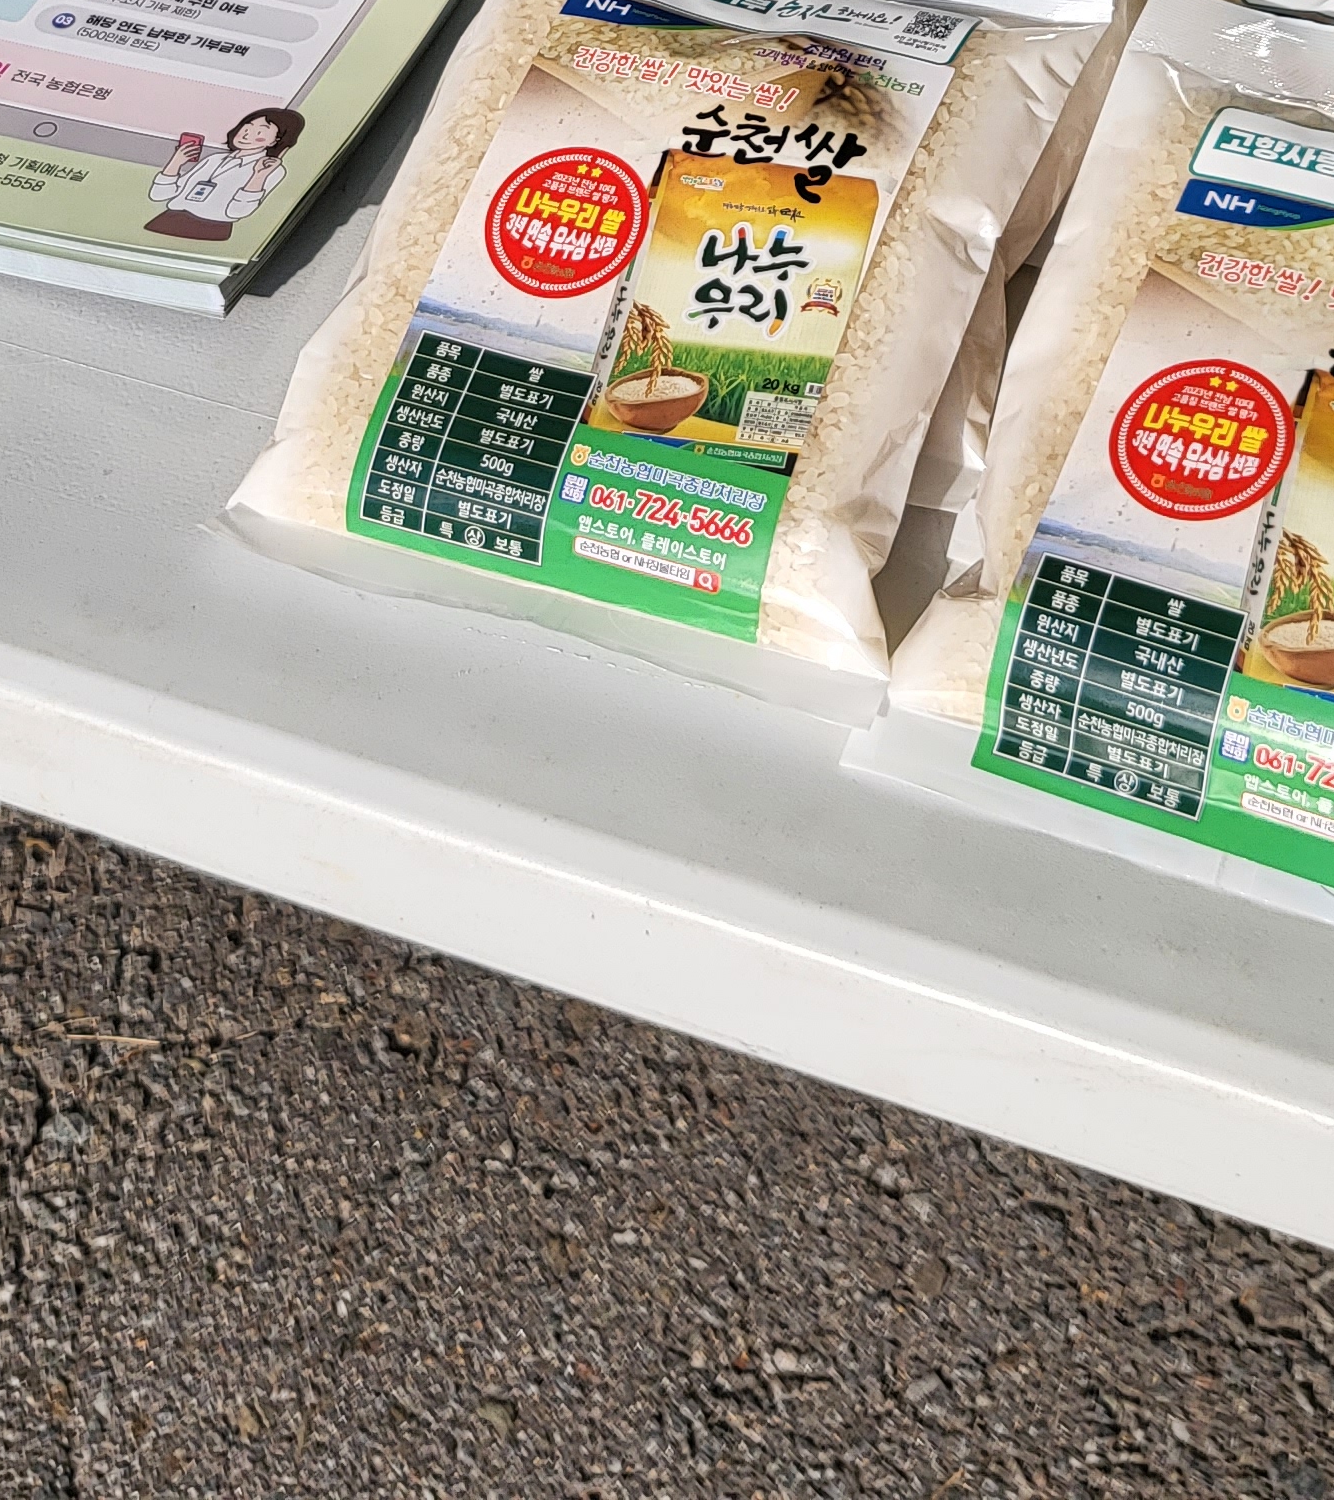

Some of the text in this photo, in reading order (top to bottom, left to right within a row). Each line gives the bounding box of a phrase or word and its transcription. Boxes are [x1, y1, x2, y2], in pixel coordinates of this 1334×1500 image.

[145, 0, 171, 13] 기부
[218, 1, 249, 15] 여부
[56, 14, 252, 57] 03 해당 연도 납부한 기부금액
[131, 38, 161, 53] 한도)
[11, 69, 47, 87] 전국
[45, 77, 113, 101] 농협은행
[573, 46, 641, 76] 건강한
[686, 64, 751, 102] 맛있는
[9, 155, 90, 183] 기획예산실
[680, 104, 868, 203] 순천쌀
[516, 187, 627, 236] 나누우리 쌀
[1203, 189, 1256, 215] NH
[505, 212, 618, 261] 3년 연속 우수상 선정
[699, 227, 813, 282] 나누
[1198, 251, 1274, 290] 건강한
[688, 278, 790, 336] 우리
[425, 362, 556, 410] 품종 별도표기
[435, 340, 545, 384] 품목 쌀
[395, 403, 536, 454] 생산년도 별도표기
[409, 384, 537, 431] 원산지 국내산
[1142, 403, 1269, 456] 나누우리 쌀
[398, 431, 515, 476] 중량 500g
[377, 478, 513, 529] 도정일 별도표기
[384, 454, 547, 512] 생산자 순천농협미곡종합처리장
[587, 450, 767, 513] 순천농협미곡종합처리장
[379, 505, 524, 556] 등급 특 상 보통
